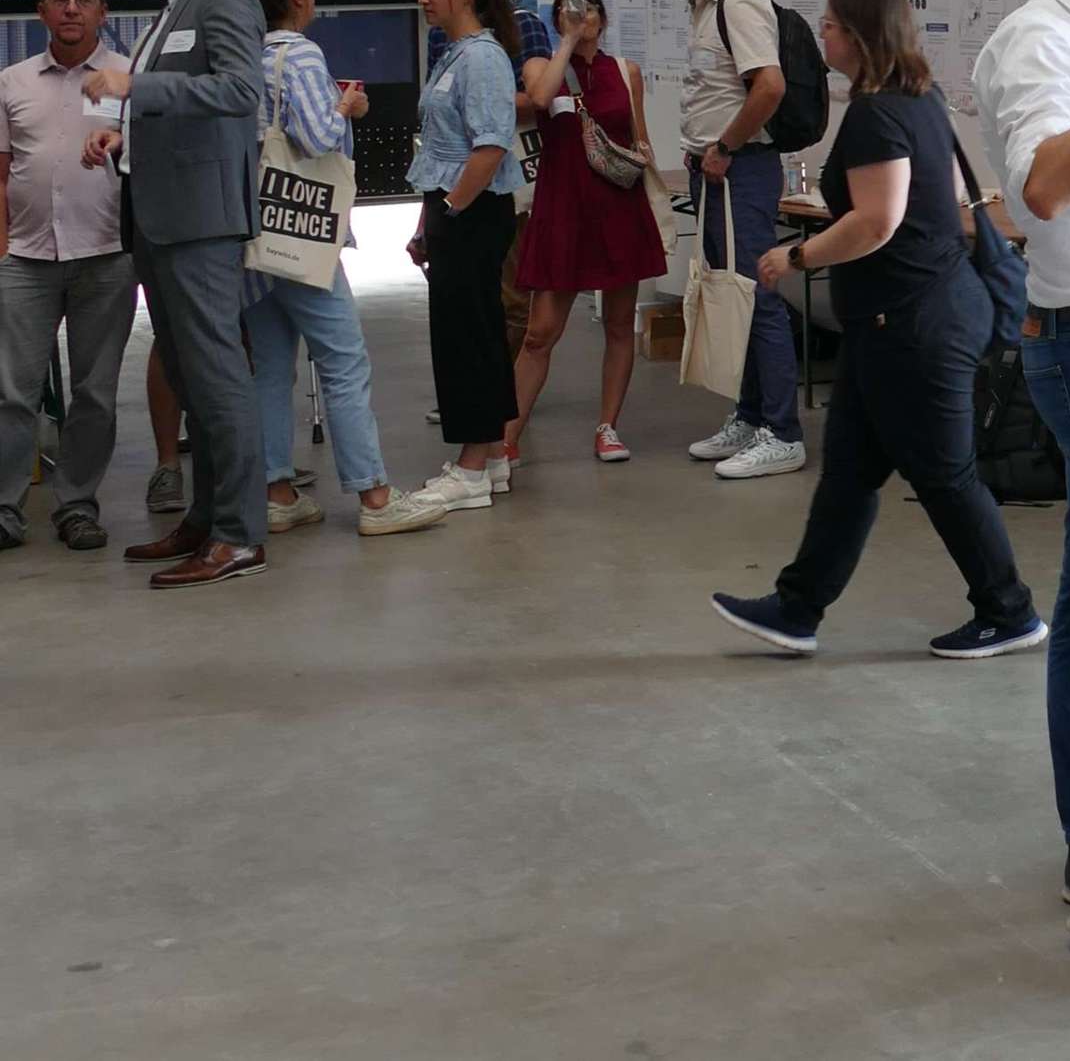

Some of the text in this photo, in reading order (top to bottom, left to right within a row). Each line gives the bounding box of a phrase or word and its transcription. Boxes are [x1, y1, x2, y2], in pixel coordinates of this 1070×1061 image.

[266, 173, 328, 210] I LOVE
[259, 204, 333, 239] CIENCE
